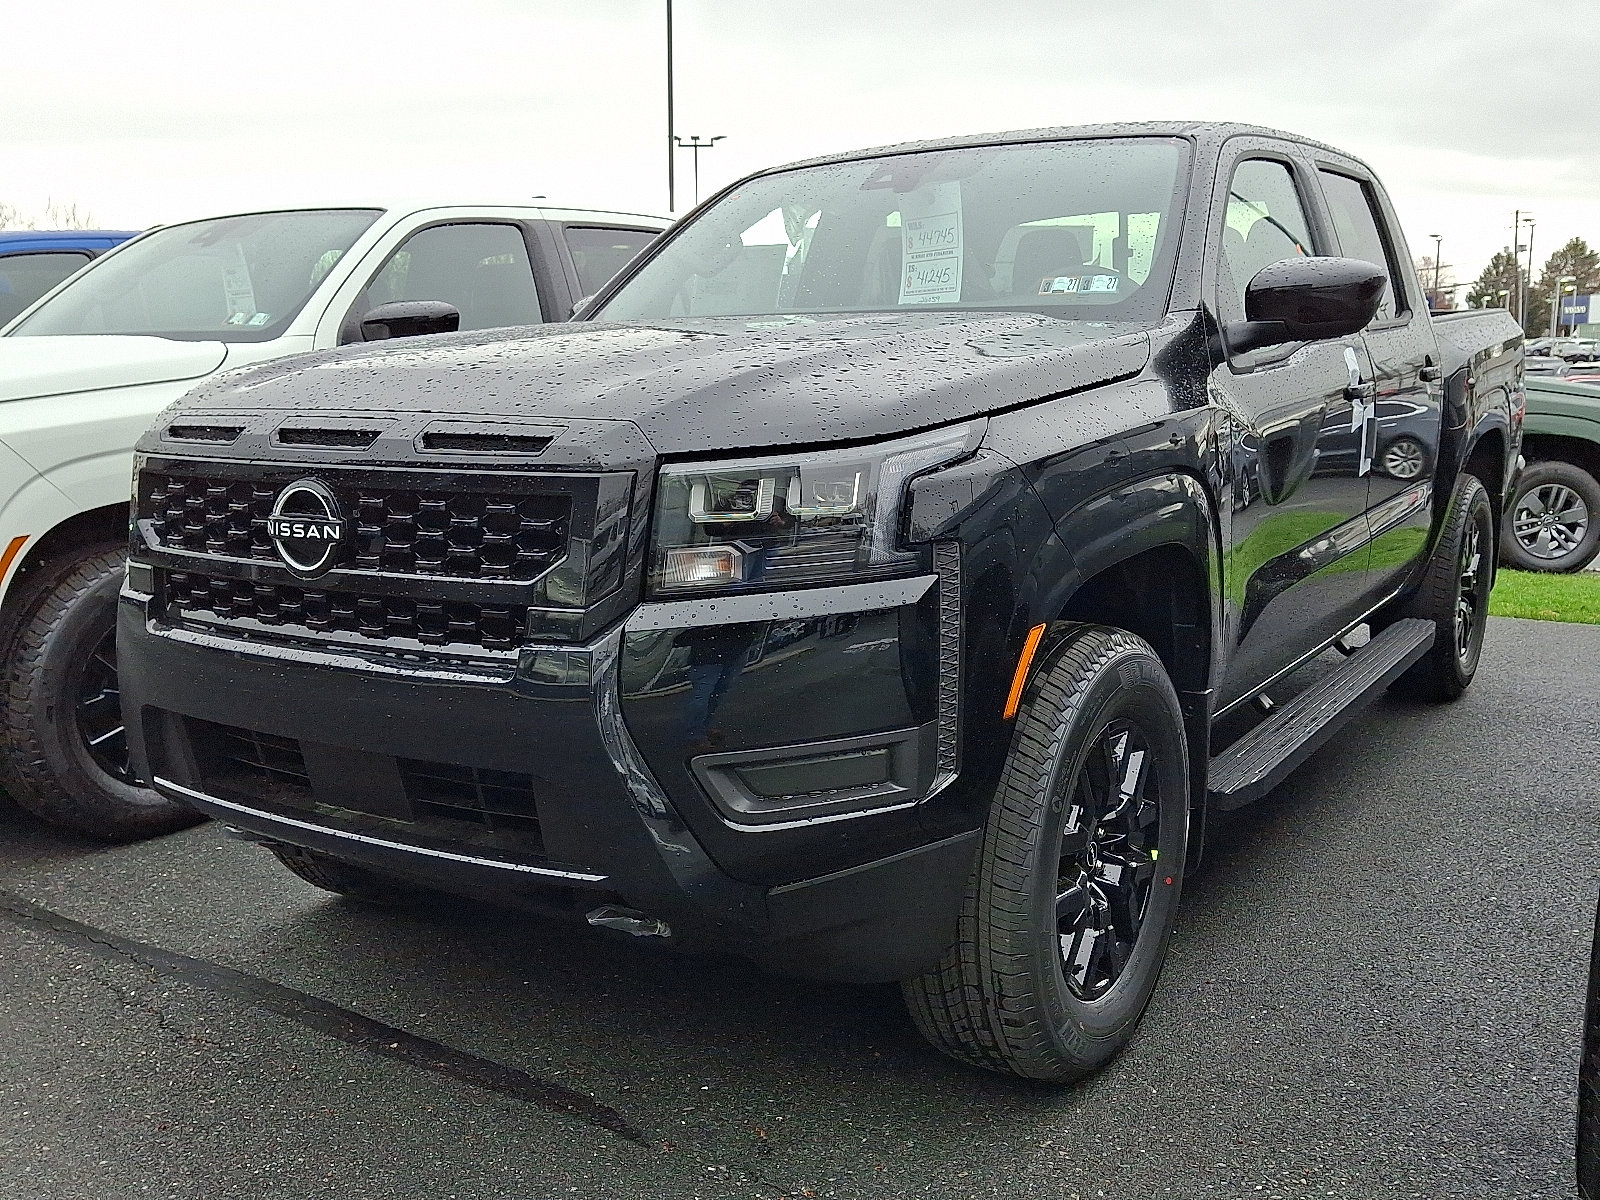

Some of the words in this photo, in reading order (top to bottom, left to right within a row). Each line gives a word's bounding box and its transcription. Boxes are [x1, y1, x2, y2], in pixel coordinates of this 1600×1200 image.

[918, 227, 955, 246] 44745
[916, 267, 950, 285] 41245
[1066, 278, 1078, 291] 27
[1106, 277, 1118, 290] 27
[268, 520, 340, 540] NISSAN
